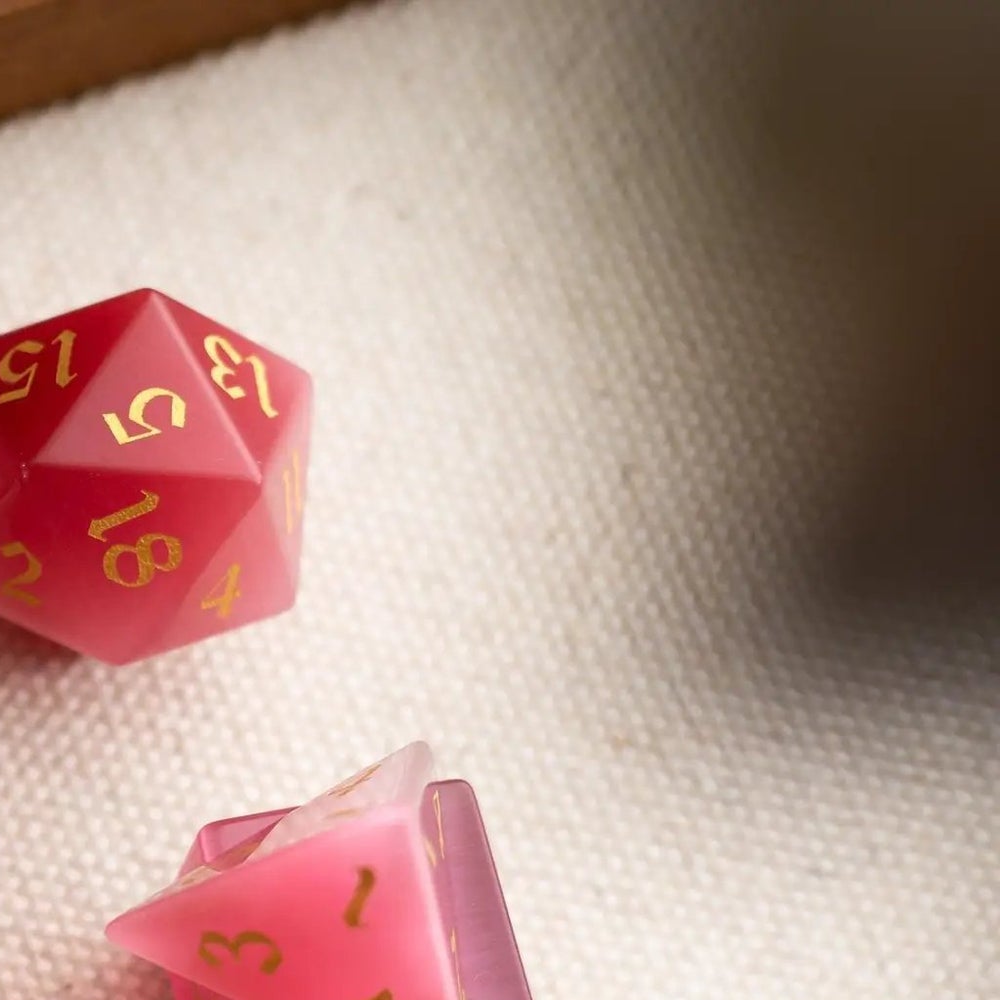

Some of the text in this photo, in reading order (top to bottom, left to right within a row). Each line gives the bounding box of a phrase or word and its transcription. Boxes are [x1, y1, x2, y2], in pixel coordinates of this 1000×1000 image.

[203, 334, 280, 419] 13
[102, 386, 187, 446] 5
[88, 489, 183, 588] 18
[0, 541, 43, 607] 2
[201, 563, 241, 618] 4
[343, 865, 377, 929] 1
[198, 930, 284, 975] 3
